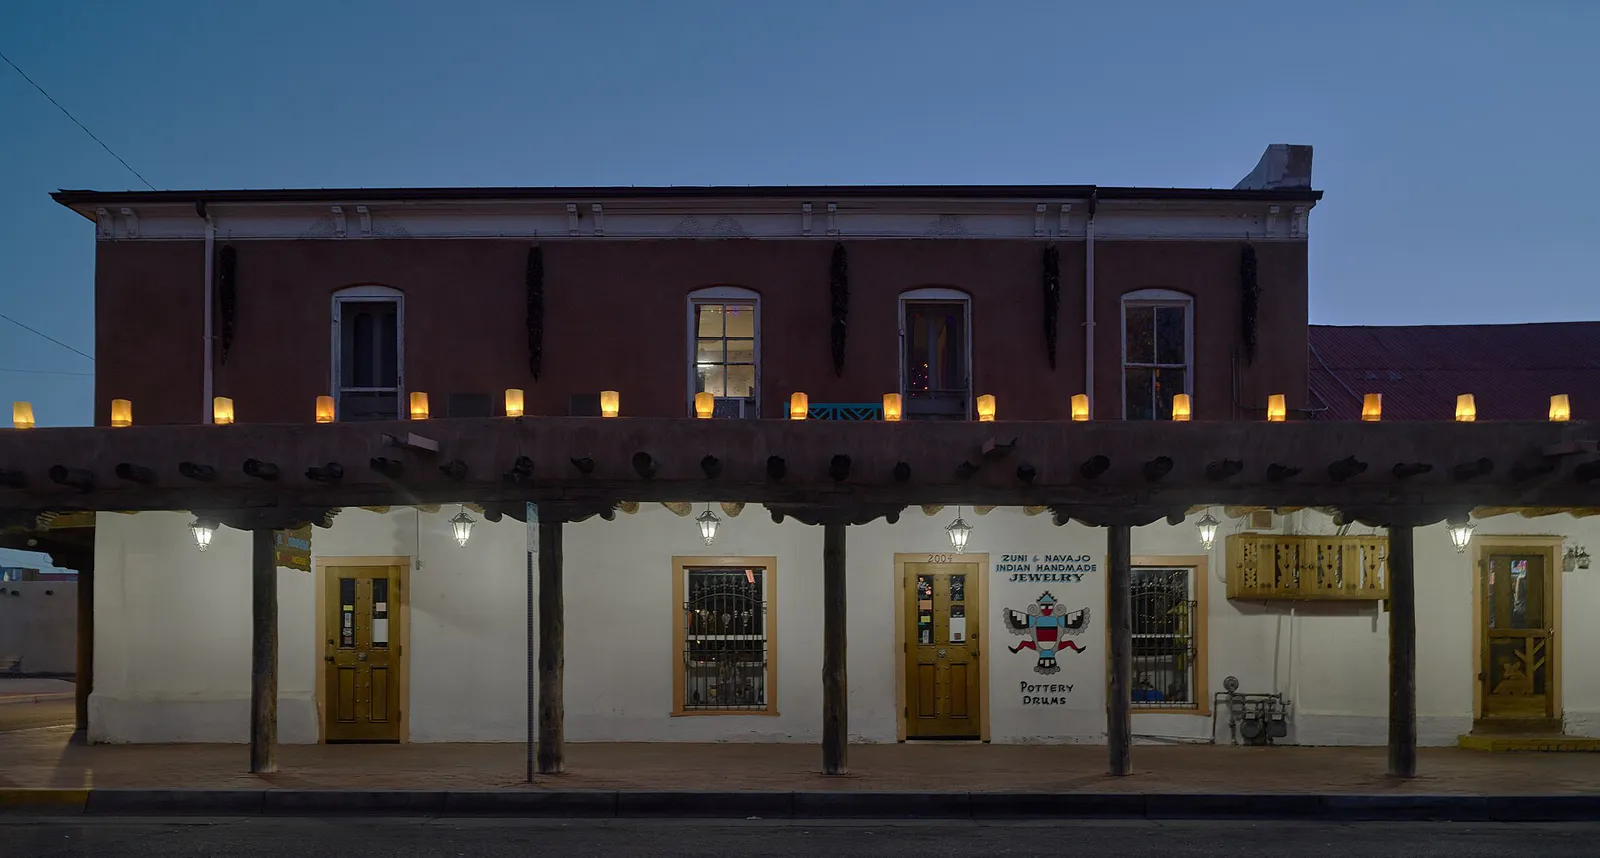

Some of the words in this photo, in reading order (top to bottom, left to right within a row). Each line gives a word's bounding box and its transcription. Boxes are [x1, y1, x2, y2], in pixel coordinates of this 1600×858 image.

[928, 554, 953, 563] 2004
[1001, 554, 1028, 562] ZUNI
[1045, 554, 1091, 562] NAVAJO
[996, 564, 1031, 572] INDIAN
[1036, 564, 1097, 572] HANDMADE
[1009, 573, 1085, 582] JEWELRY
[1020, 681, 1074, 693] POTTERY
[1023, 696, 1067, 705] DRUMS
